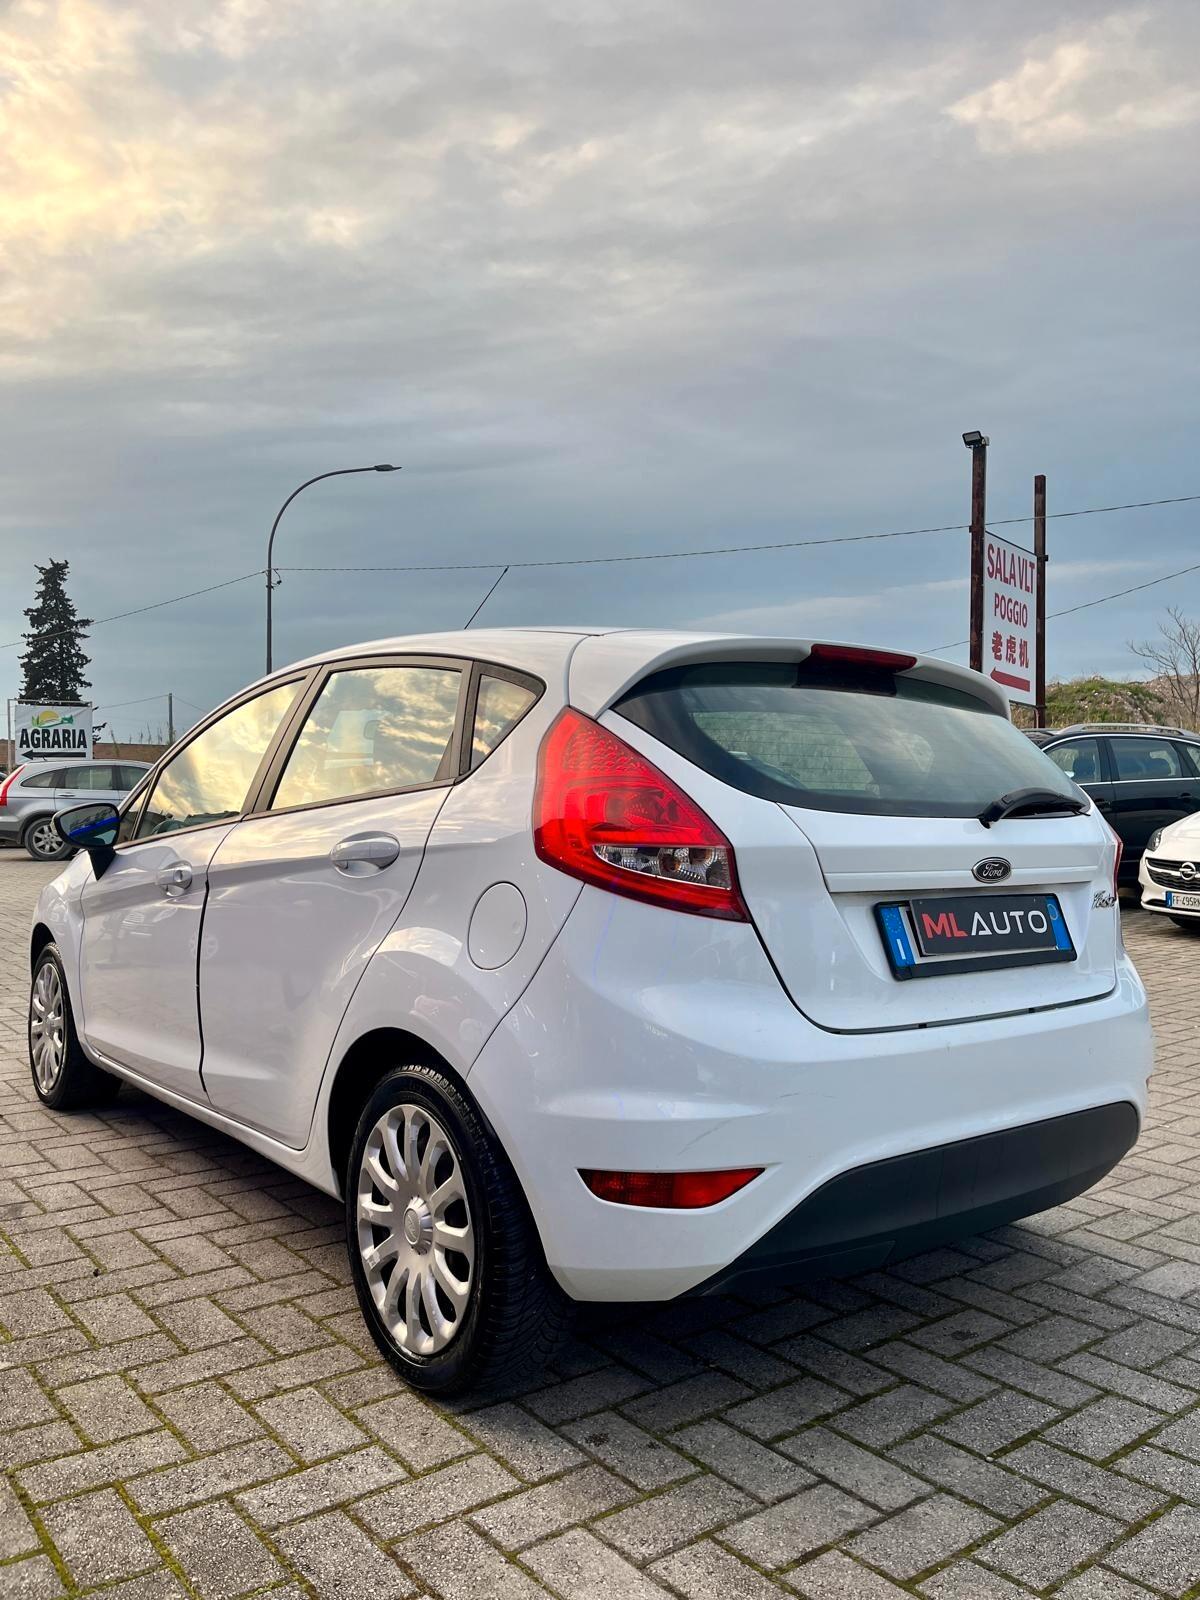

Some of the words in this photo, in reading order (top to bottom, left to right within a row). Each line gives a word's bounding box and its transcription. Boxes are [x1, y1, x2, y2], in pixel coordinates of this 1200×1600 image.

[987, 543, 1016, 588] SALA
[1017, 555, 1036, 594] VLT
[994, 592, 1028, 628] POGGIO
[991, 630, 1029, 669] 老虎机
[19, 728, 88, 749] AGRARIA
[982, 862, 1004, 877] Ford
[921, 912, 969, 939] ML
[971, 910, 1048, 936] AUTO
